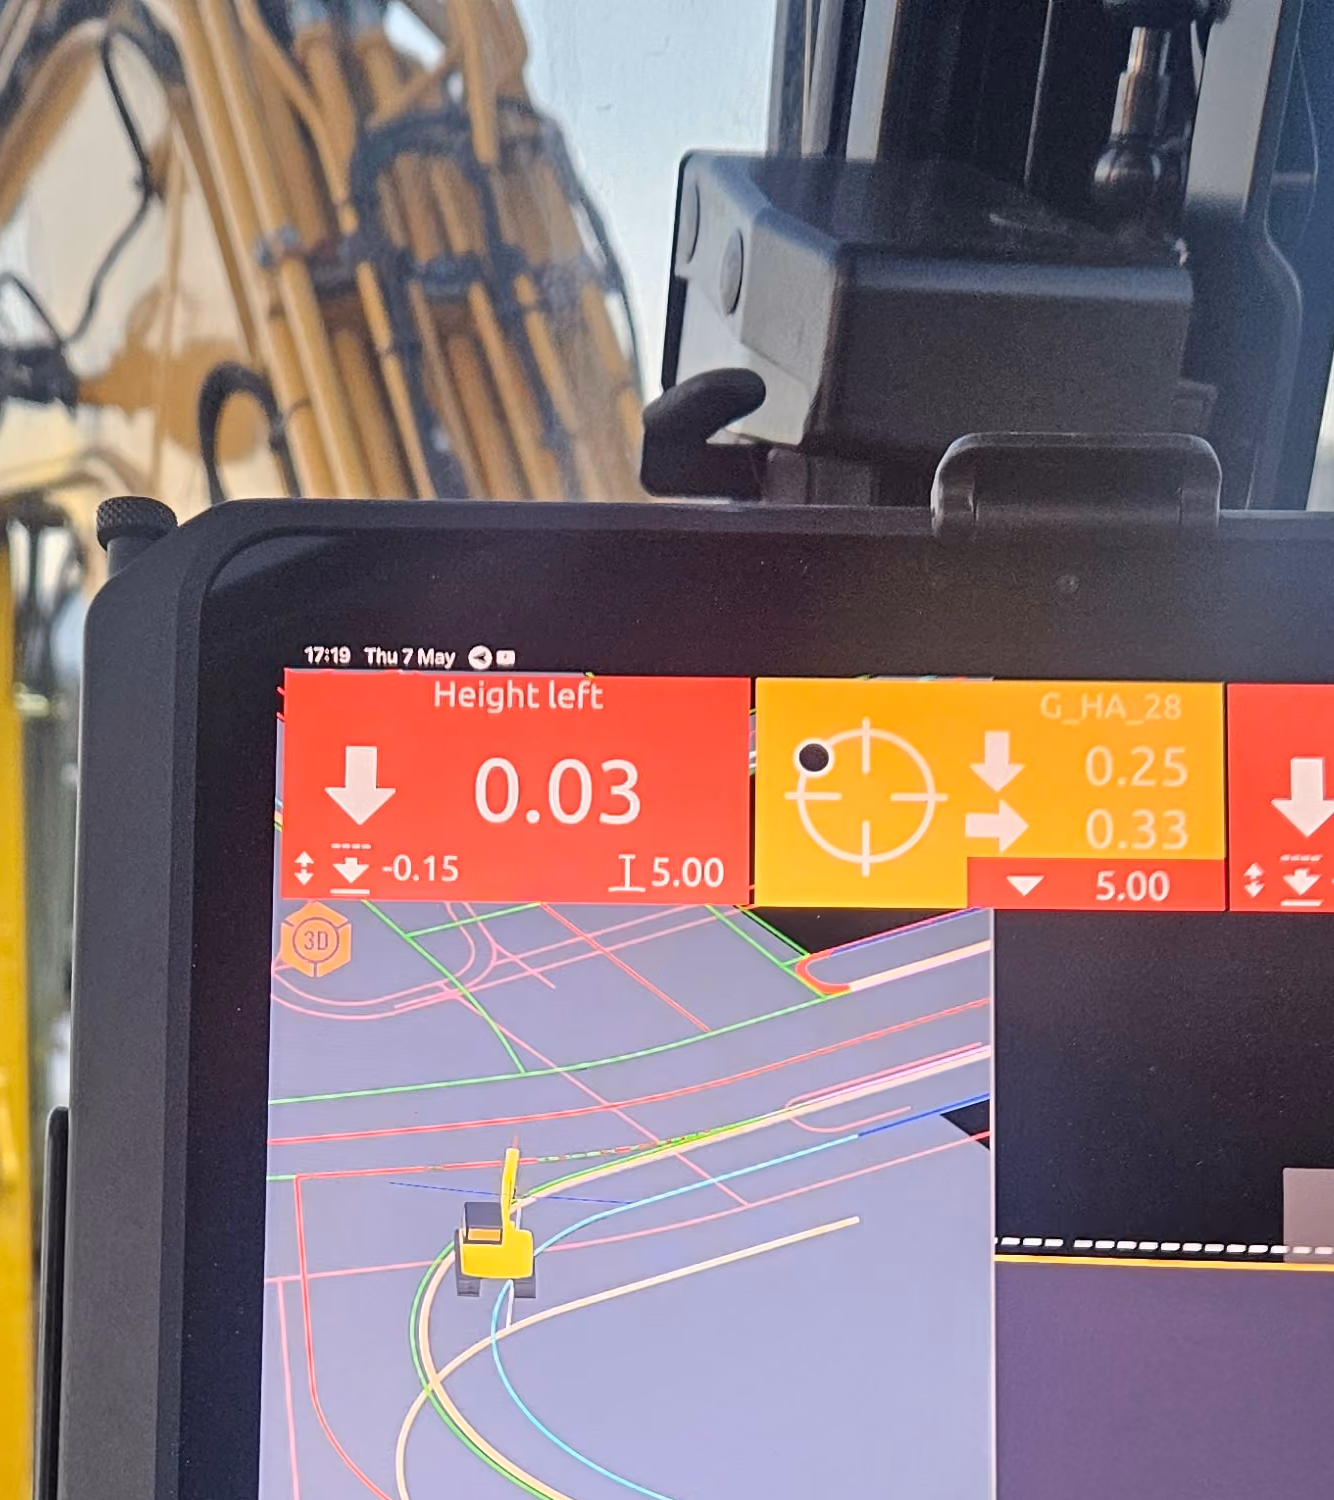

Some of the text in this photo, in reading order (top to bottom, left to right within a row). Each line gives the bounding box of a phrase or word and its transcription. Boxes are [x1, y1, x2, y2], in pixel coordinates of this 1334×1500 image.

[304, 645, 457, 670] 17:19 Thu 7 May
[434, 679, 604, 715] Height left
[1040, 691, 1182, 726] G_HA_28
[1084, 745, 1189, 788] 0.25
[474, 757, 642, 825] 0.03
[1085, 808, 1190, 850] 0.33
[381, 853, 460, 883] -0.15
[650, 856, 726, 888] 5.00
[1095, 869, 1171, 902] 5.00
[303, 930, 329, 951] 3D
